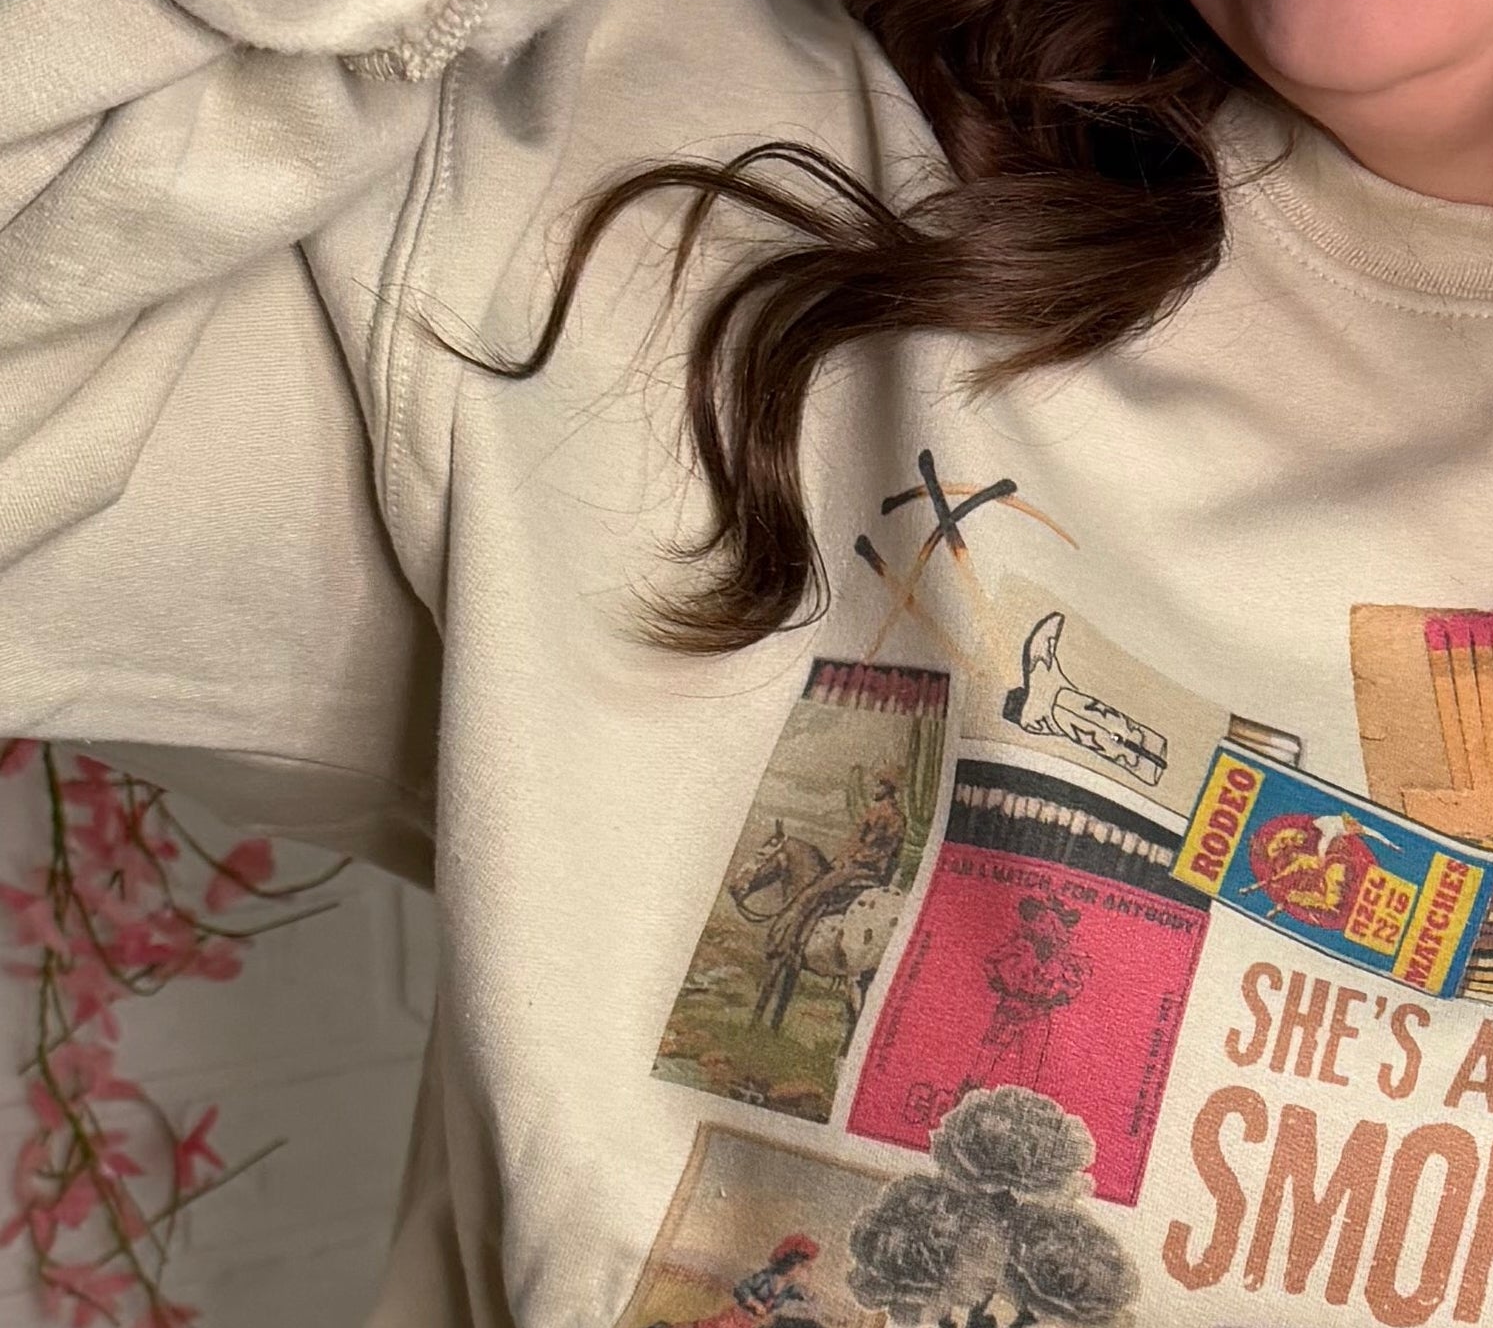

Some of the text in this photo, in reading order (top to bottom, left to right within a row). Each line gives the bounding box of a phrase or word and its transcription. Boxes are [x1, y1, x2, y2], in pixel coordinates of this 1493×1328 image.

[1190, 768, 1257, 882] RODEO
[1403, 859, 1469, 988] MATCHES
[1225, 962, 1431, 1099] SHE'S
